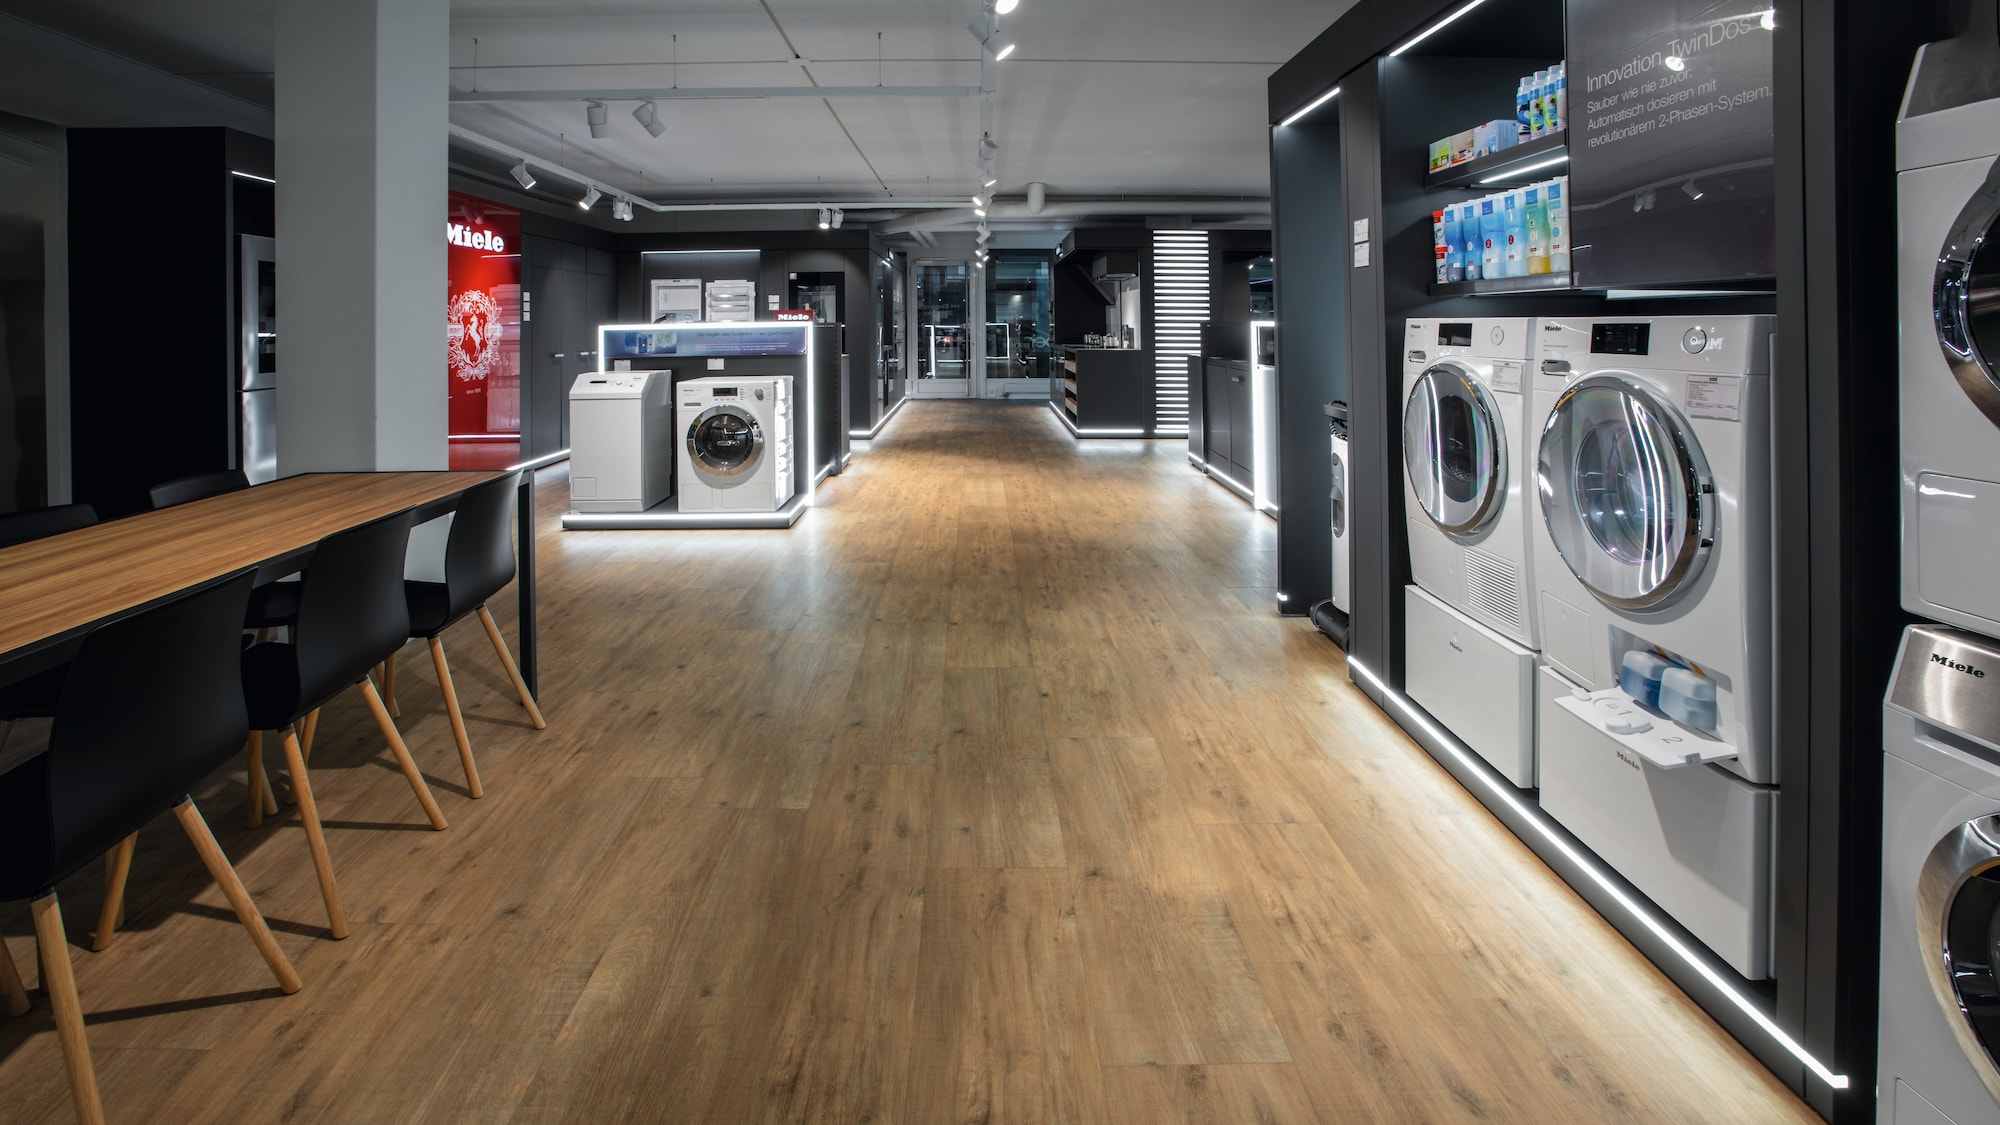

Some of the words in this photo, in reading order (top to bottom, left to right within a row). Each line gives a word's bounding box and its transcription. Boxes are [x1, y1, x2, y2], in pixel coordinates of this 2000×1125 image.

[1587, 51, 1662, 93] Innovation
[1587, 92, 1619, 114] Sauber
[1621, 86, 1639, 102] wie
[1641, 79, 1657, 95] nie
[1587, 103, 1645, 131] Automatisch
[1647, 87, 1694, 113] dosieren
[1698, 78, 1718, 97] mit
[1587, 119, 1656, 148] revolutionärem
[1659, 85, 1774, 128] 2-Phasen-System.
[447, 222, 505, 253] Miele
[1929, 652, 1986, 678] Miele
[1661, 736, 1684, 744] 2
[1616, 751, 1640, 771] Miele
